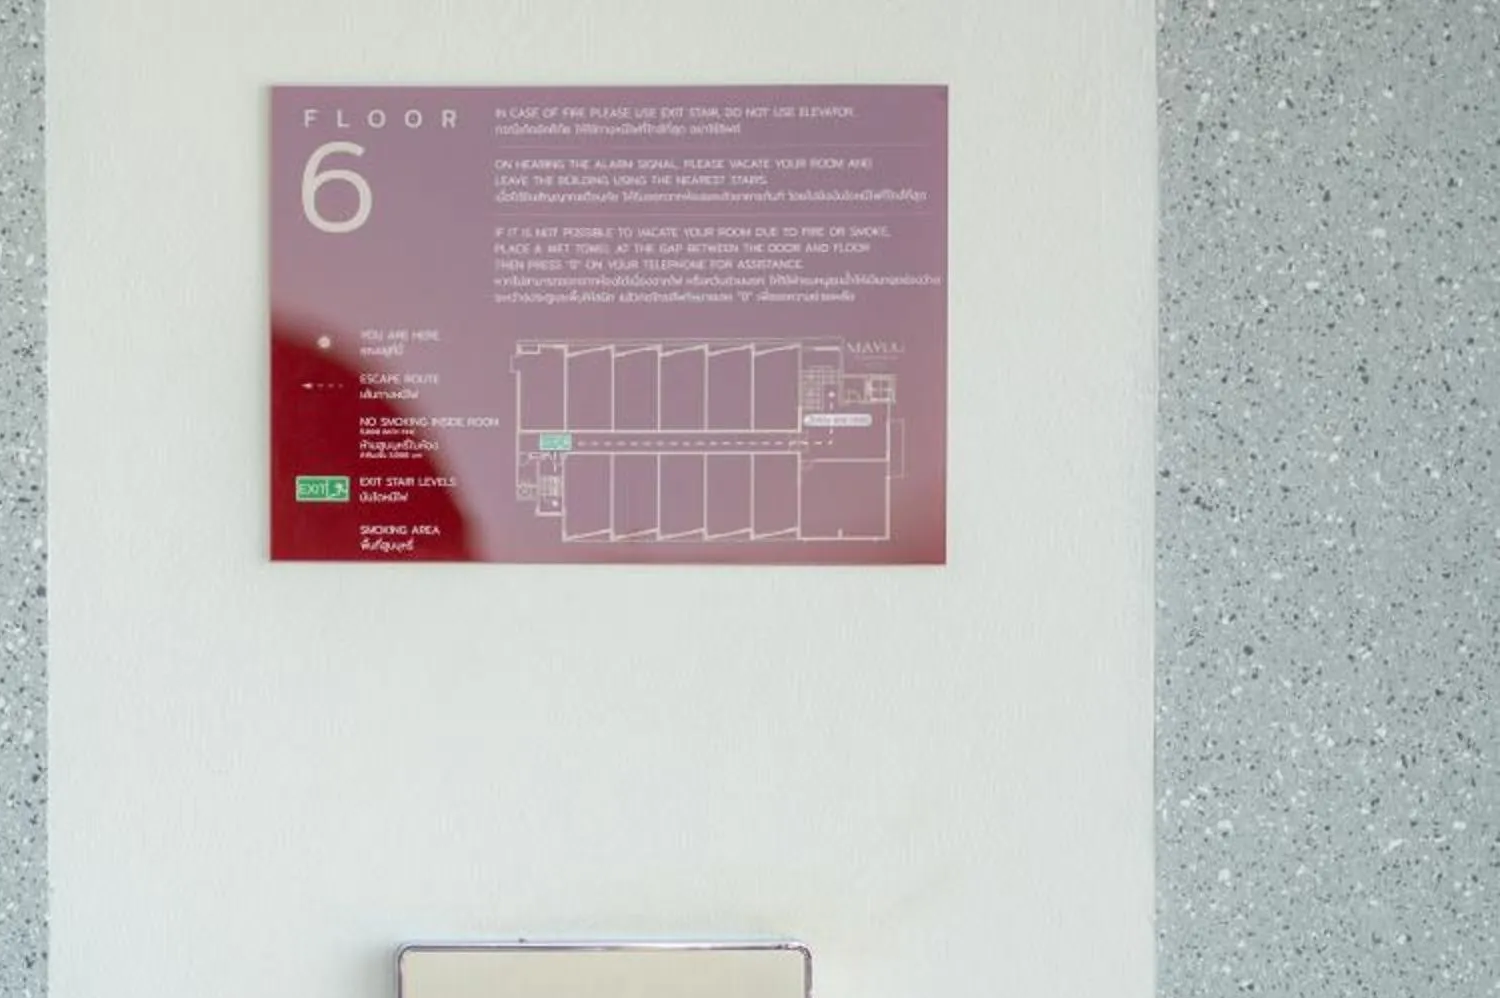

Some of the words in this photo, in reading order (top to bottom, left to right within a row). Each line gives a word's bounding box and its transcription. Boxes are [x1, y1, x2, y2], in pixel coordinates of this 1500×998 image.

[304, 109, 457, 128] FLOOR
[302, 141, 372, 233] 6
[359, 373, 400, 384] ESCAPE
[403, 373, 439, 384] ROUTE
[359, 417, 377, 428] NO
[380, 417, 428, 428] SMOKING
[431, 417, 465, 428] INSIDE
[467, 417, 499, 428] ROOM
[359, 477, 381, 487] EXIT
[385, 477, 414, 487] STAIR
[417, 477, 456, 487] LEVELS
[299, 484, 325, 495] EXIT
[359, 525, 408, 536] SMOKING
[411, 525, 441, 536] AREA
